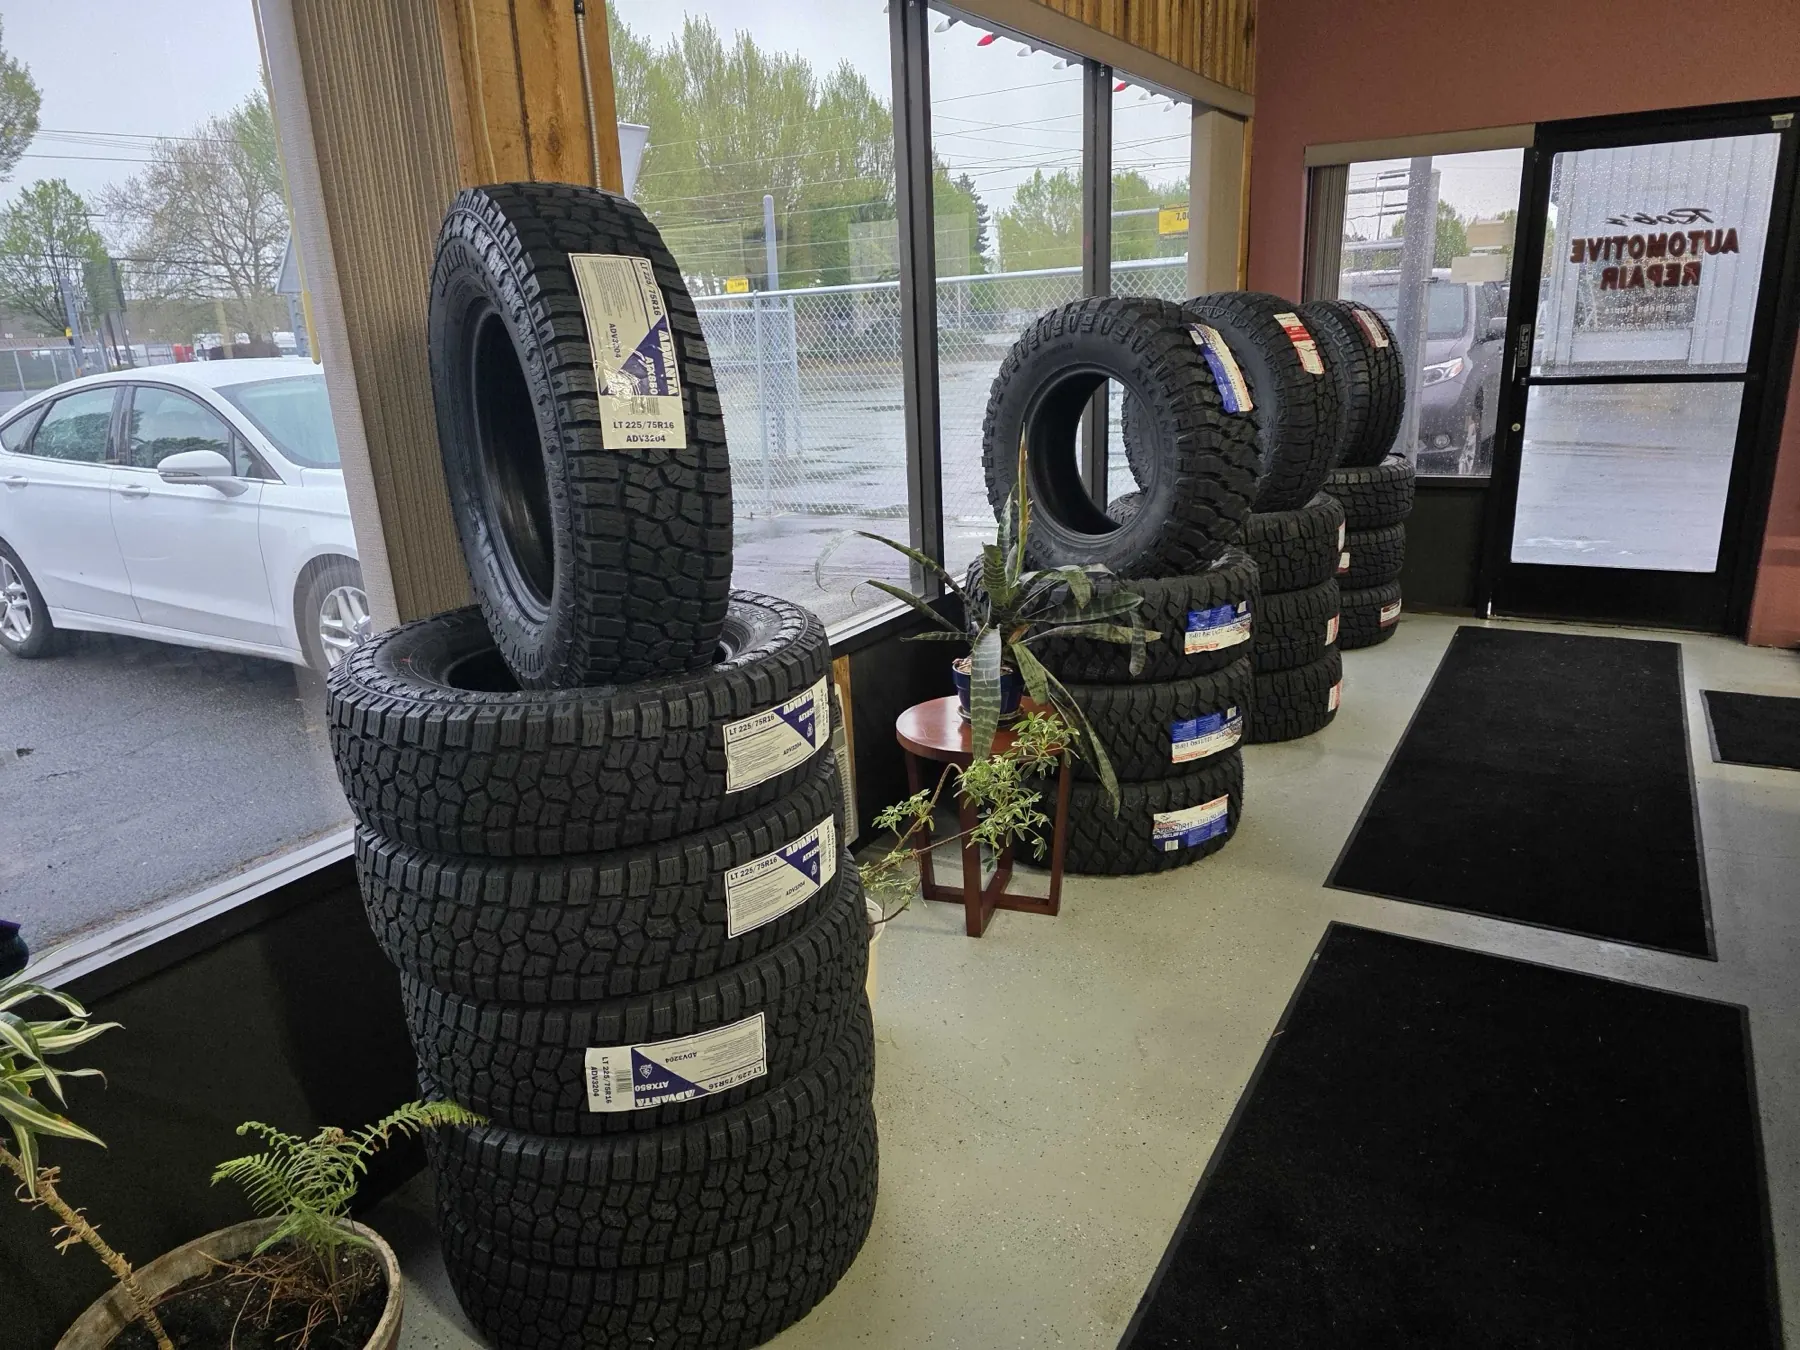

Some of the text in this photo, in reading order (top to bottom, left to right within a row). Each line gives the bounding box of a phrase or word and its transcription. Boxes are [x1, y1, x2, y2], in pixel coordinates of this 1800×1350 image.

[1519, 328, 1529, 357] PUSH
[657, 330, 678, 396] ADVANTA
[613, 420, 675, 430] LT 225/75R16
[783, 691, 814, 716] ADVANTA
[738, 714, 775, 733] 225/75R16
[786, 829, 819, 857] ADVANTA
[730, 857, 778, 882] LT 225/75R16
[665, 1052, 698, 1064] ADV3204
[590, 1066, 600, 1097] ADV3204
[602, 1056, 612, 1104] LT 225/75R16
[635, 1081, 669, 1092] ATX850
[708, 1066, 762, 1091] LT 225/75R16
[636, 1089, 696, 1107] ADVANTA
